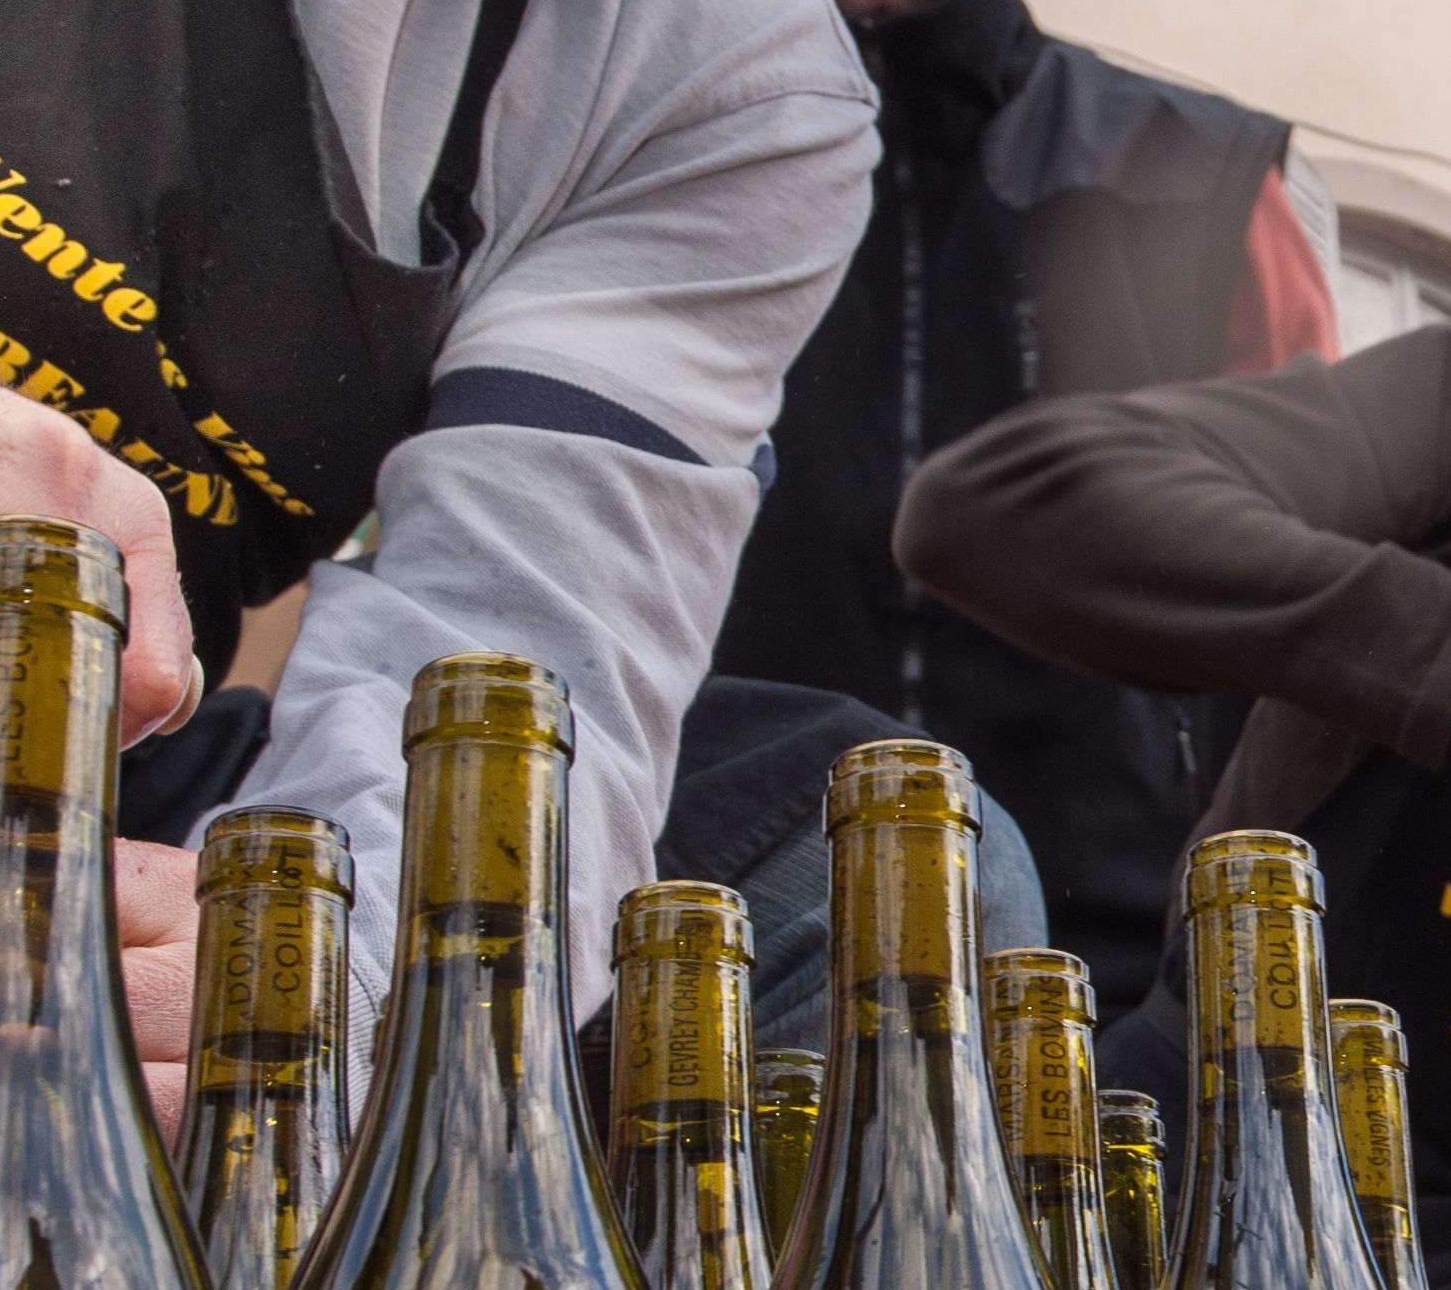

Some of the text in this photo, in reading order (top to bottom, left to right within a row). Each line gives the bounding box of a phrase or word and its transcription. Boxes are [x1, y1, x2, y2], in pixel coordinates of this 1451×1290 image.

[667, 1018, 700, 1087] GEVREY
[1040, 976, 1071, 1138] LES BOIVINS
[1367, 1110, 1391, 1168] VIGNES
